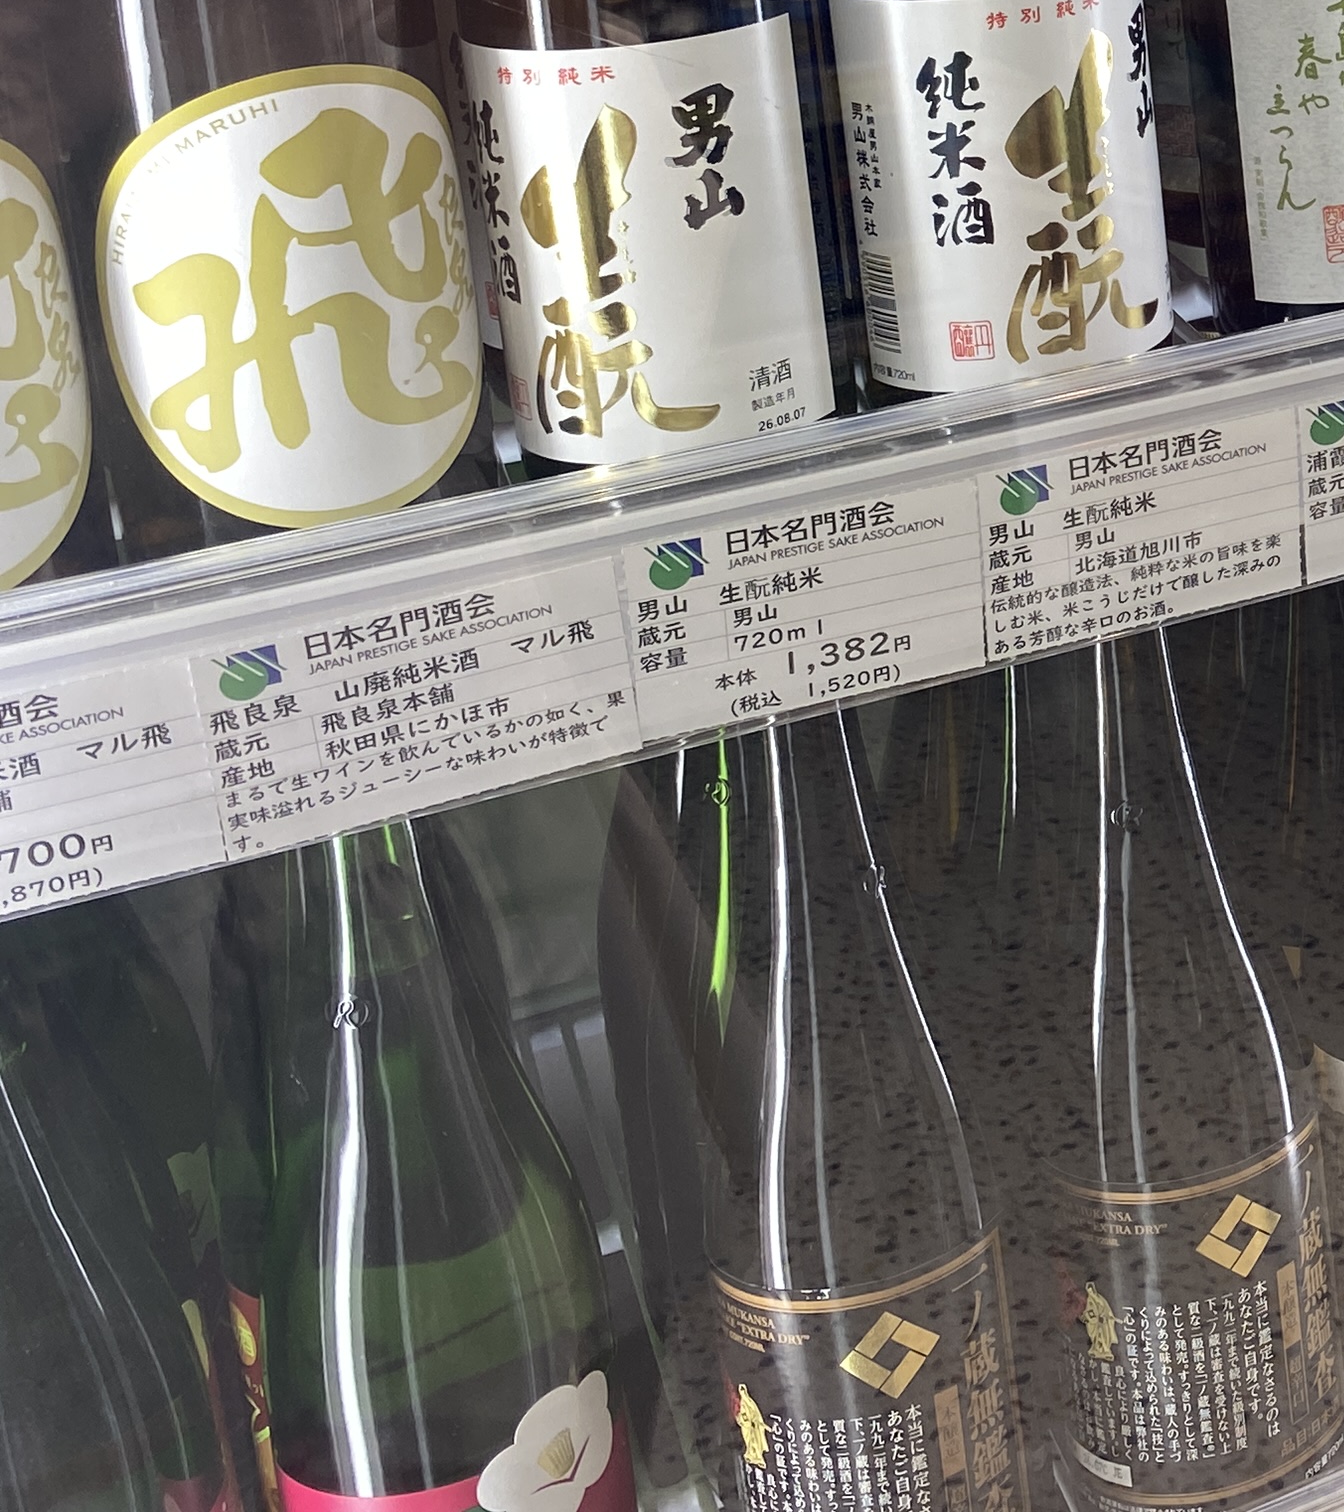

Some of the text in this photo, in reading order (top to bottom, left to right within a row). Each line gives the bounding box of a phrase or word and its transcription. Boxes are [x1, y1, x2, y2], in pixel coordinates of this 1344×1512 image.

[497, 66, 615, 86] 特別純米
[173, 97, 280, 155] MARUHI
[915, 51, 996, 246] 純米酒
[664, 83, 745, 230] 男山
[850, 101, 878, 237] 男山株式会社
[472, 99, 522, 304] 純米酒
[748, 358, 792, 392] 清酒
[751, 387, 796, 411] 製造年月
[1069, 429, 1222, 482] 日本名門酒会
[726, 501, 895, 556] 日本名門酒会
[728, 516, 944, 570] JAPAN PRESTIGE SAKE ASSOCIATION
[989, 528, 1115, 571] 蔵元 男山
[991, 532, 1203, 596] 産地 北海道旭川市
[304, 593, 494, 660] 日本名門酒会
[638, 604, 778, 648] 蔵元 男山
[209, 620, 595, 735] 飛良泉 山廃純米酒 マル飛
[715, 632, 911, 690] 本体 1,382円
[731, 664, 900, 718] (税込 1,520円)
[19, 707, 124, 741] ASSOCIATION
[214, 683, 455, 763] 蔵元 飛良泉本舗
[221, 697, 510, 788] 産地 秋田県にかほ市
[1237, 1289, 1264, 1420] あなたご自身です。
[1253, 1280, 1281, 1437] 本当に鑑定なさるのは
